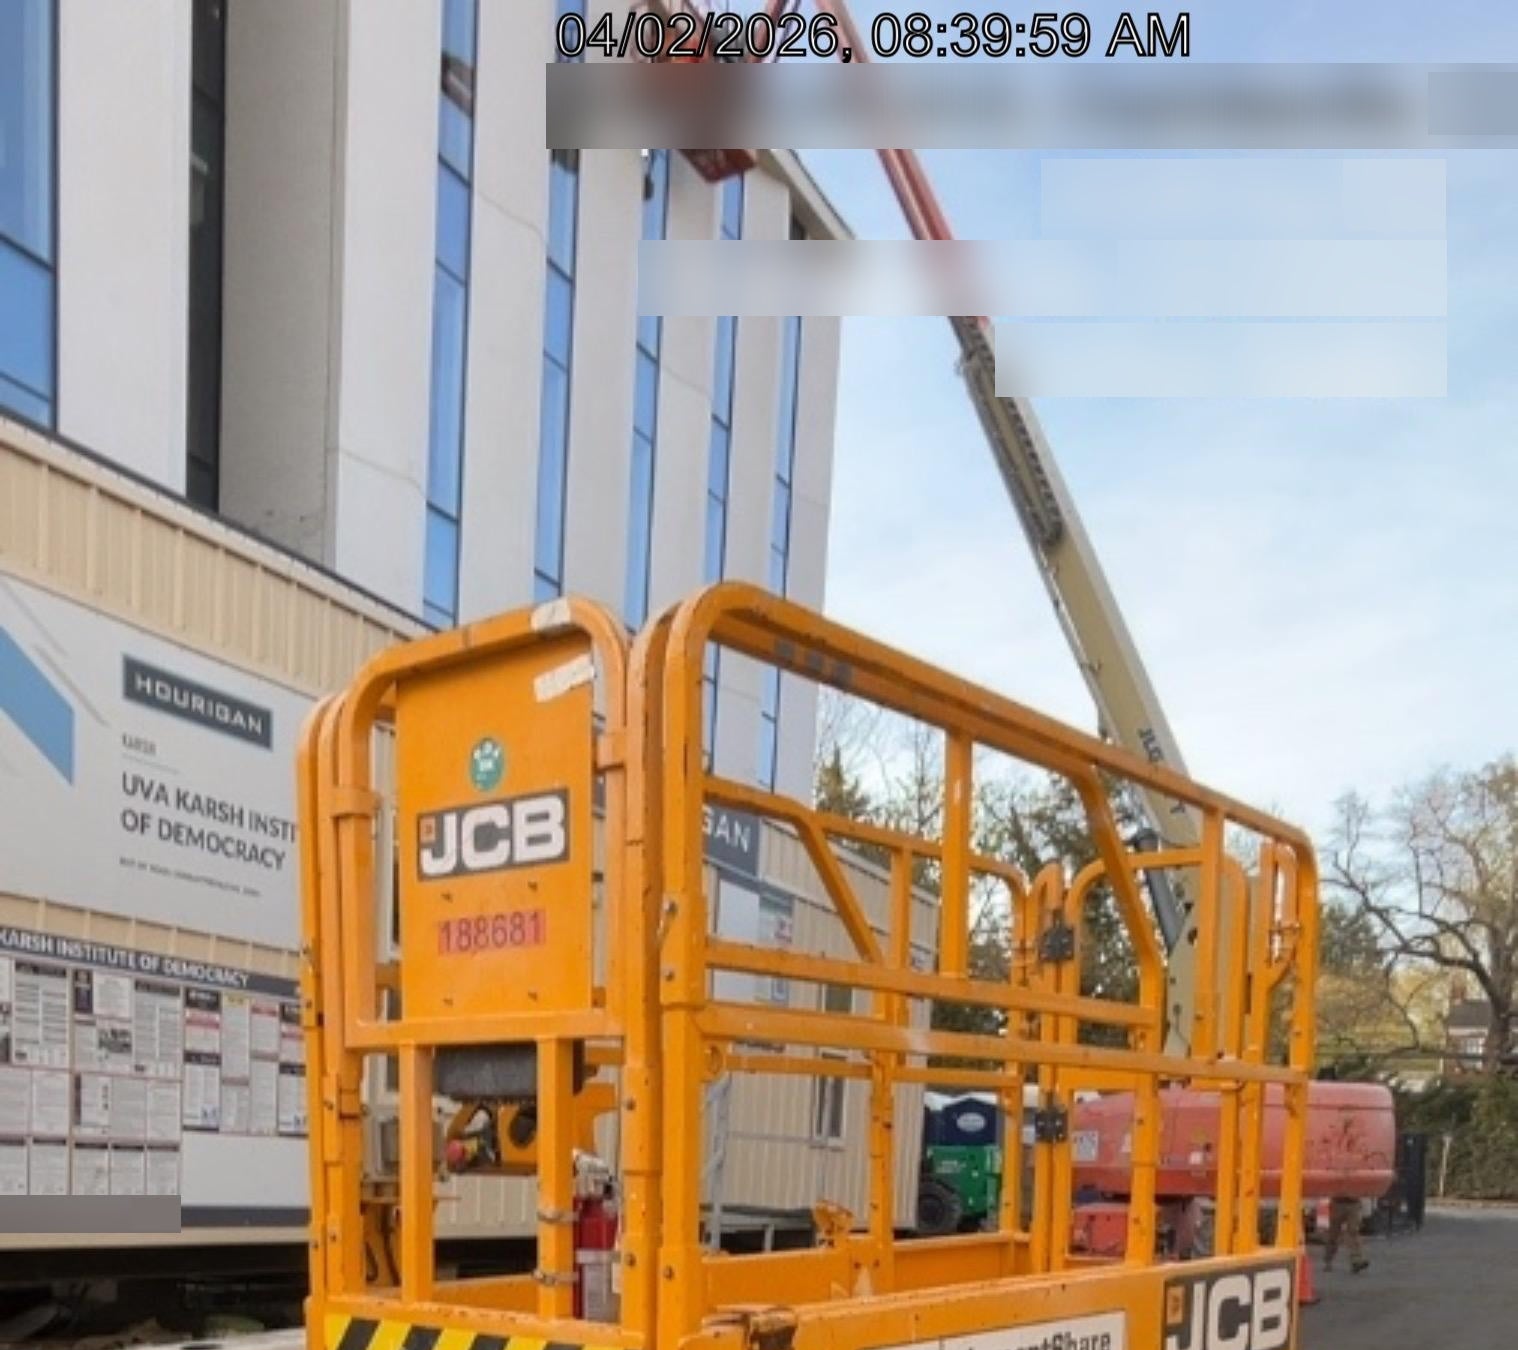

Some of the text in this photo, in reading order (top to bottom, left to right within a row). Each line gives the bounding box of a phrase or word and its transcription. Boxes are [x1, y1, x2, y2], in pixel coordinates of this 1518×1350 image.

[134, 671, 263, 736] HOURIGAN
[122, 770, 169, 806] UVA
[175, 787, 244, 829] KARSH
[120, 808, 286, 871] OF DEMOCRACY
[420, 794, 566, 877] JCB
[56, 936, 136, 969] INSTITUTE
[140, 953, 160, 972] OF
[163, 957, 249, 988] DEMOCRACY
[440, 910, 541, 953] 188681
